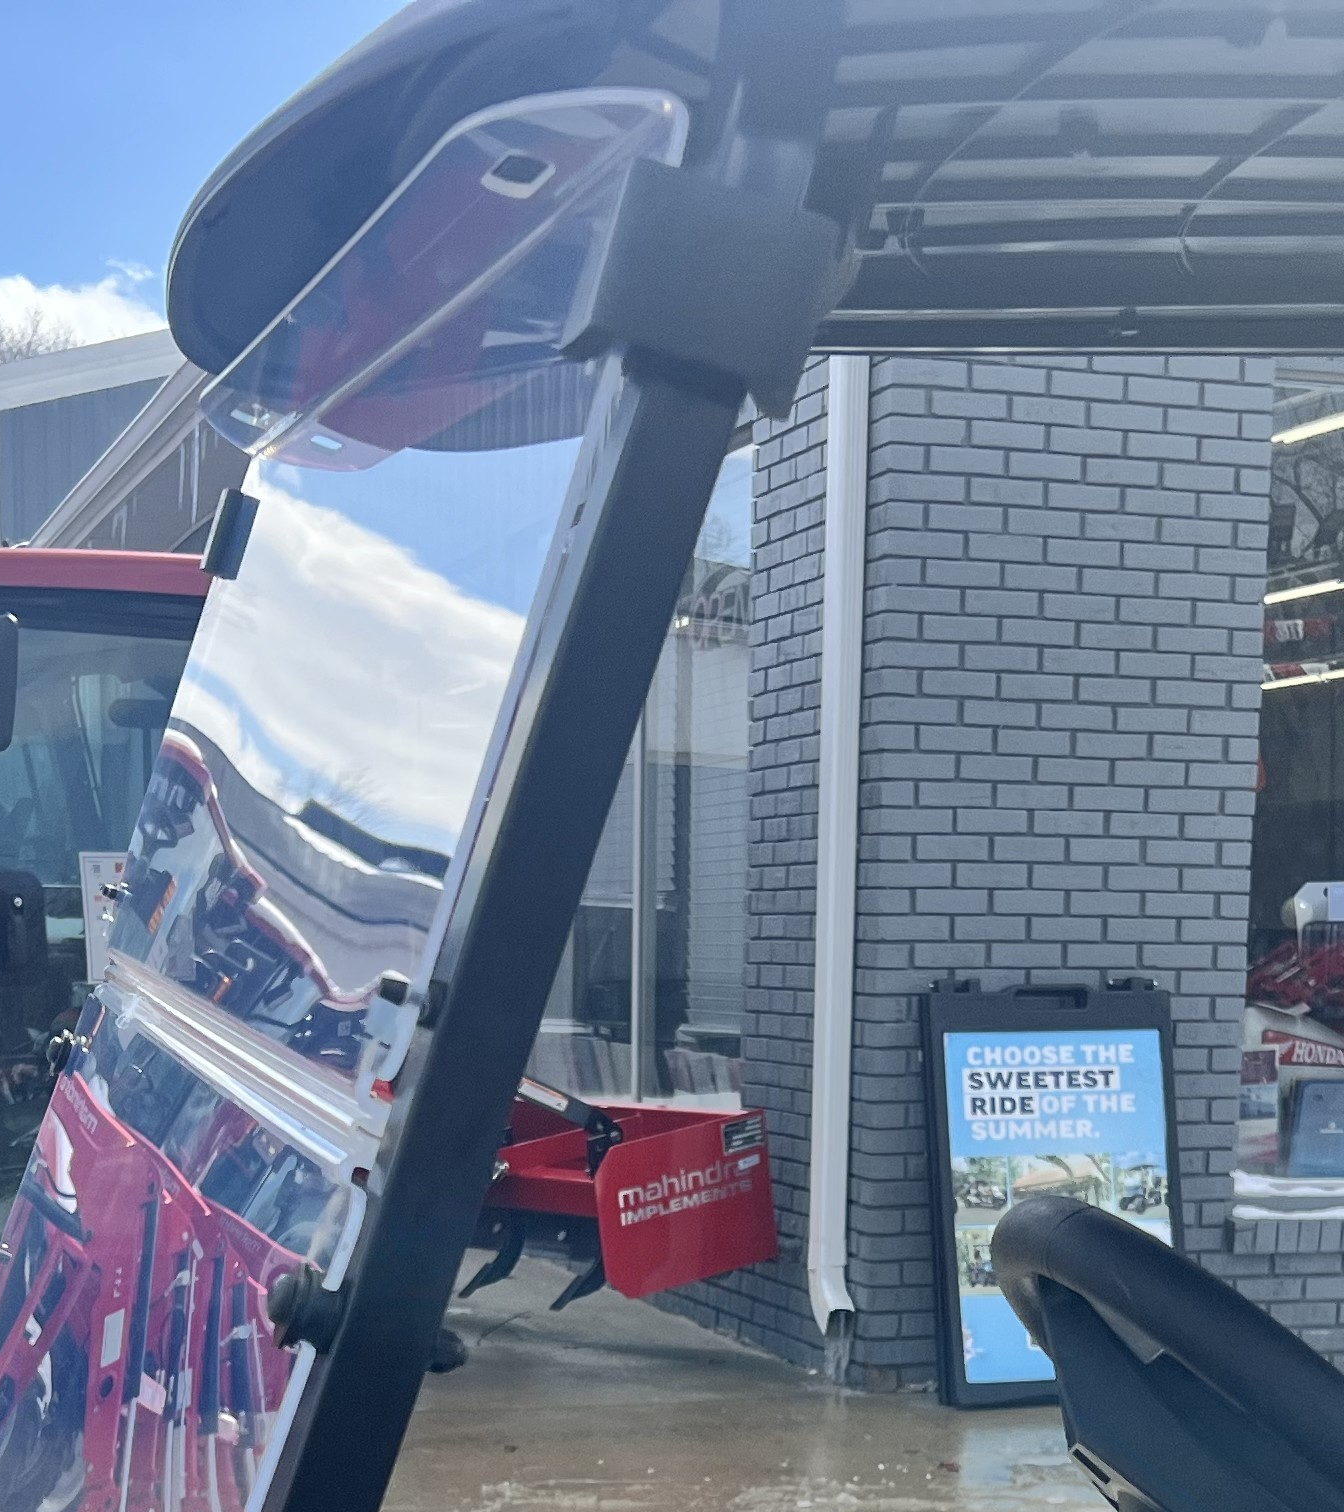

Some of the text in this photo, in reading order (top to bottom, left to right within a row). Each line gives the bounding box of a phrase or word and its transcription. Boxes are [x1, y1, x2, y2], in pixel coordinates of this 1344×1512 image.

[966, 1043, 1135, 1066] CHOOSE THE
[968, 1069, 1114, 1091] SWEETEST
[971, 1092, 1137, 1116] RIDE OF THE
[971, 1118, 1101, 1141] SUMMER.
[621, 1179, 753, 1227] IMPLEMENTS
